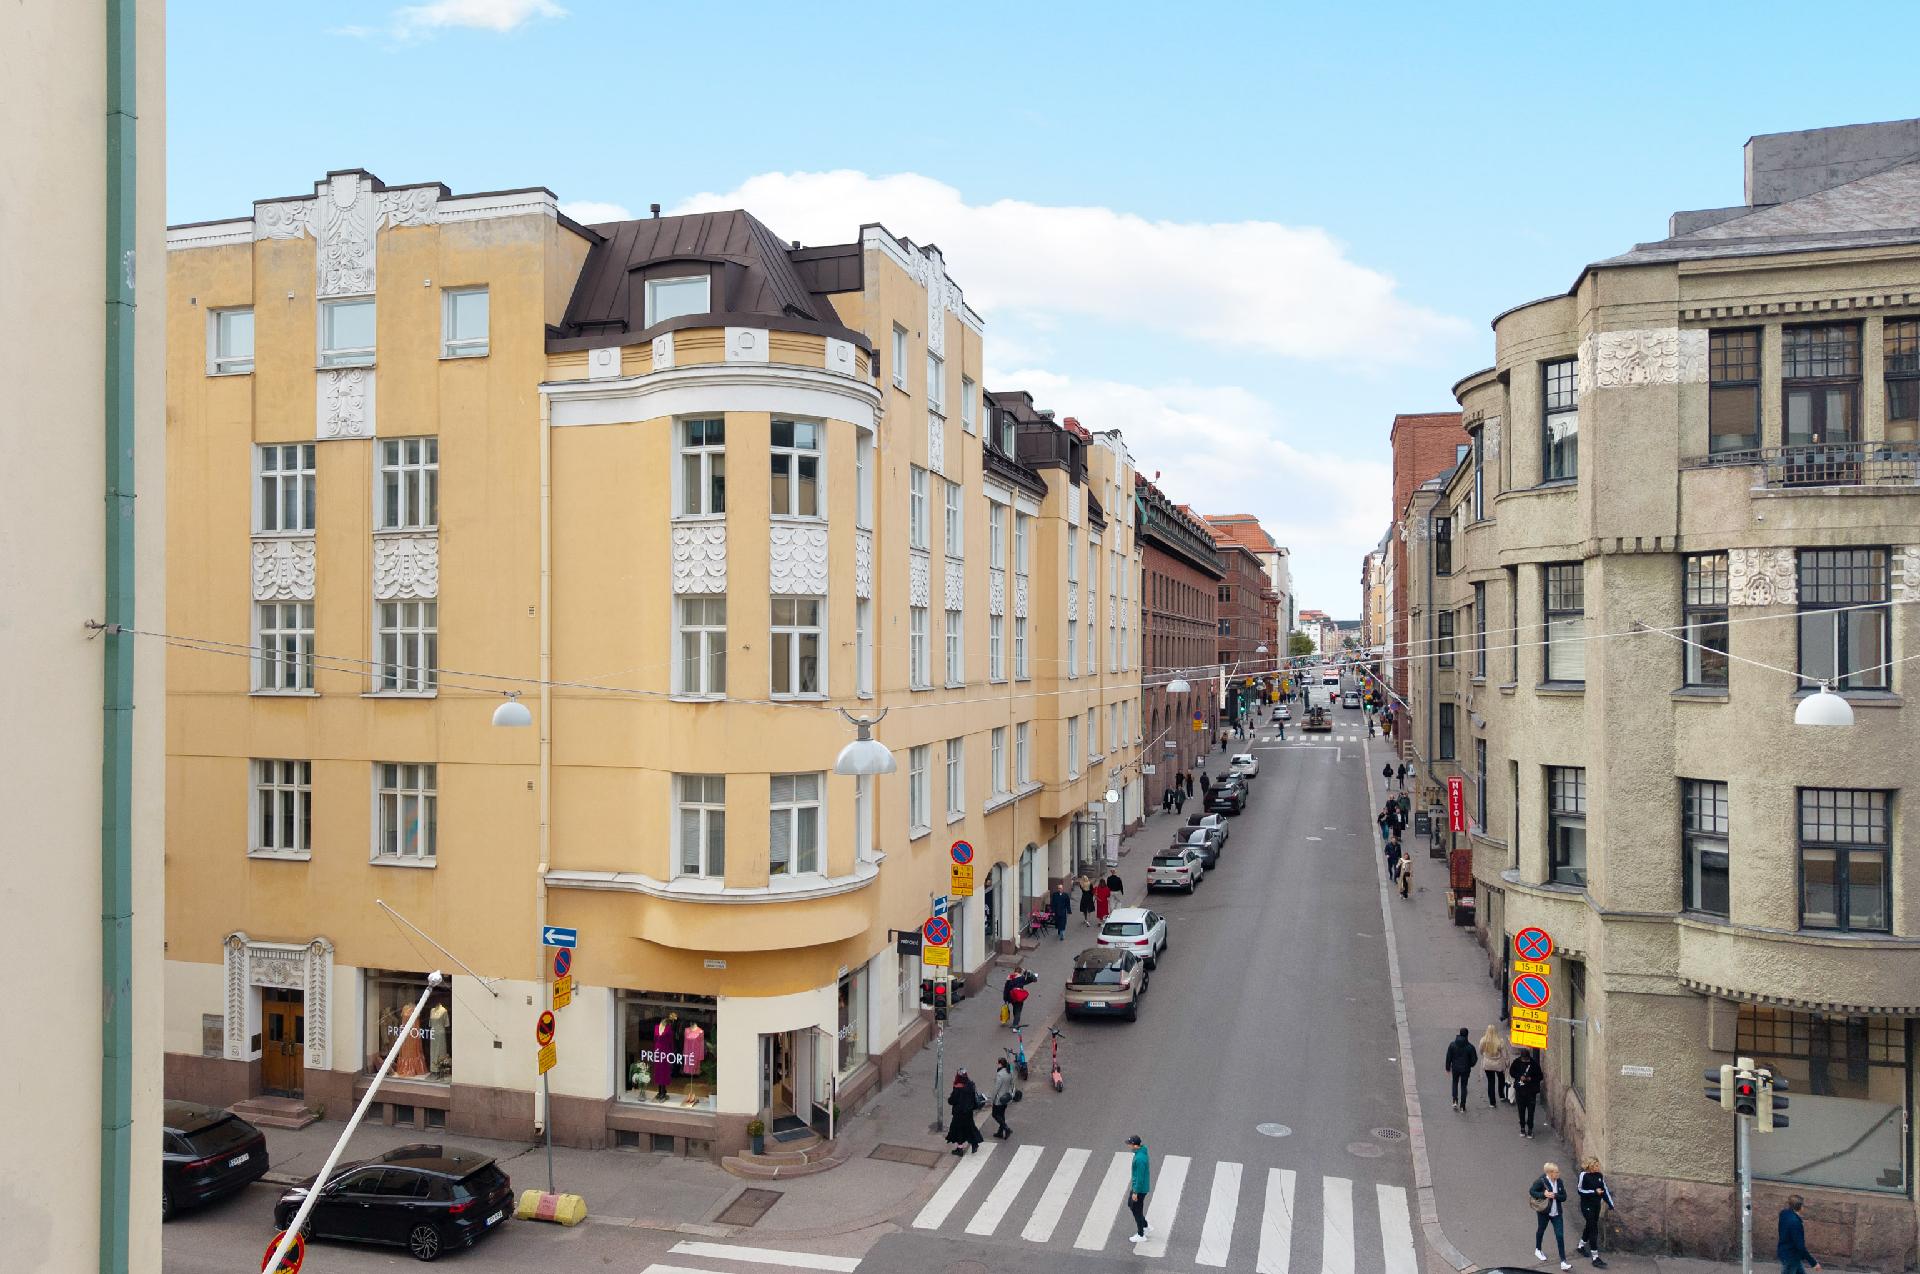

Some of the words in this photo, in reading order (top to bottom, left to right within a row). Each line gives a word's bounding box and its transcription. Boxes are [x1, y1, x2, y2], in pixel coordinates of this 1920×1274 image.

[1451, 782, 1460, 831] MATTOJA
[387, 1024, 436, 1041] PRÉORTÉ
[640, 1048, 695, 1066] PRÉPORTÉ
